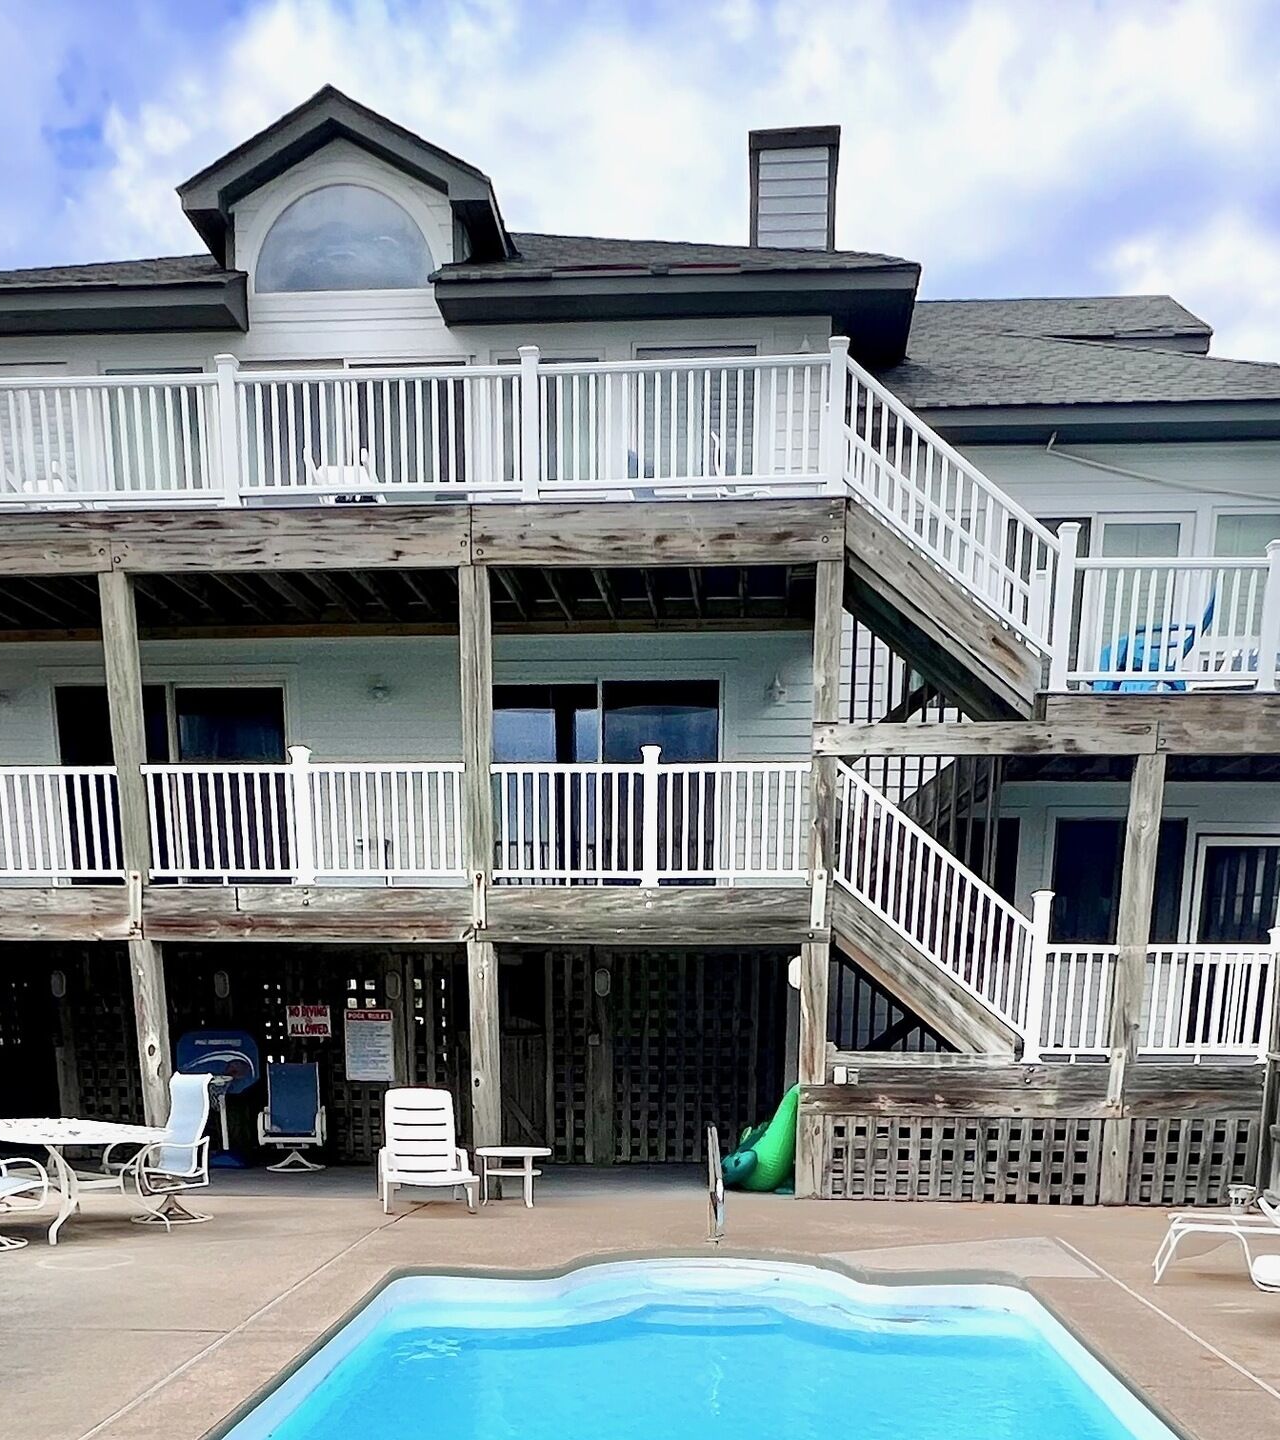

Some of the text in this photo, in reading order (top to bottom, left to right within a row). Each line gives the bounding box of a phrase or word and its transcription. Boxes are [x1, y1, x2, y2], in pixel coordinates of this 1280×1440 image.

[288, 1006, 328, 1018] NO DIVING
[290, 1023, 329, 1035] ALLOWED
